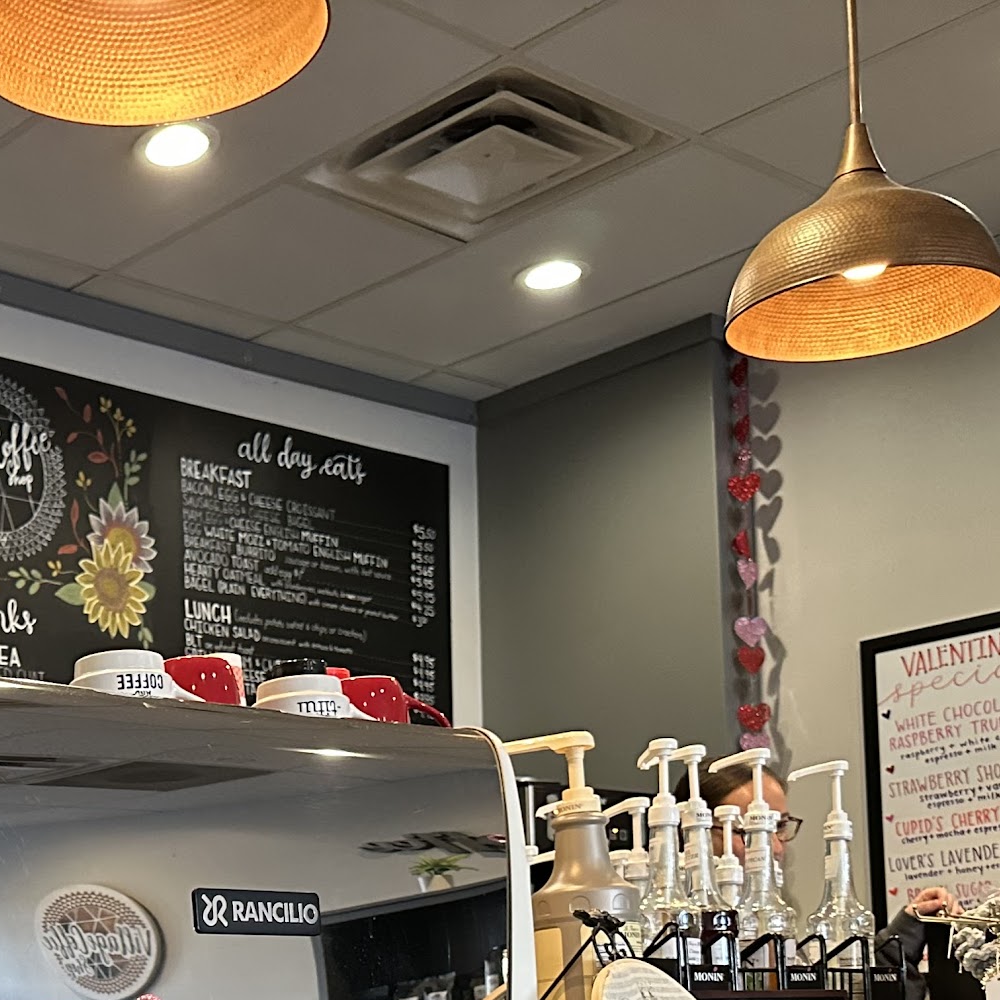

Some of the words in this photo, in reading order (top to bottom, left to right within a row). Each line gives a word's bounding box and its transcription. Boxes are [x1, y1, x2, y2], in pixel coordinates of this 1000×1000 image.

[237, 432, 272, 464] all
[277, 436, 317, 479] day
[319, 454, 367, 485] eats
[180, 457, 252, 489] BREAKFAST
[300, 531, 339, 548] MUFFIN
[231, 555, 259, 572] TOAST
[352, 551, 389, 569] MUFFIN
[184, 598, 232, 625] LUNCH
[184, 618, 230, 638] CHICKEN
[232, 625, 261, 642] SALAD
[185, 632, 203, 648] BLT
[116, 673, 163, 693] COFFEE
[894, 711, 937, 733] WHITE
[889, 724, 962, 752] RASPBERRY
[971, 719, 1000, 735] TRU
[900, 745, 945, 761] raspberry
[959, 735, 990, 748] white
[924, 749, 963, 764] espresso
[888, 767, 971, 798] STRAWBERRY
[919, 785, 976, 803] strawberry
[927, 797, 965, 810] espresso
[895, 815, 944, 837] CUPID'S
[951, 805, 999, 829] CHERRY
[901, 834, 928, 845] cherry
[936, 829, 965, 840] mocha
[887, 853, 935, 873] LOVER'S
[904, 869, 943, 881] lavender
[955, 864, 984, 876] honey
[232, 900, 319, 926] RANCILIO
[694, 971, 724, 982] MONIN
[790, 973, 817, 982] MONIN
[873, 973, 897, 982] MONIN
